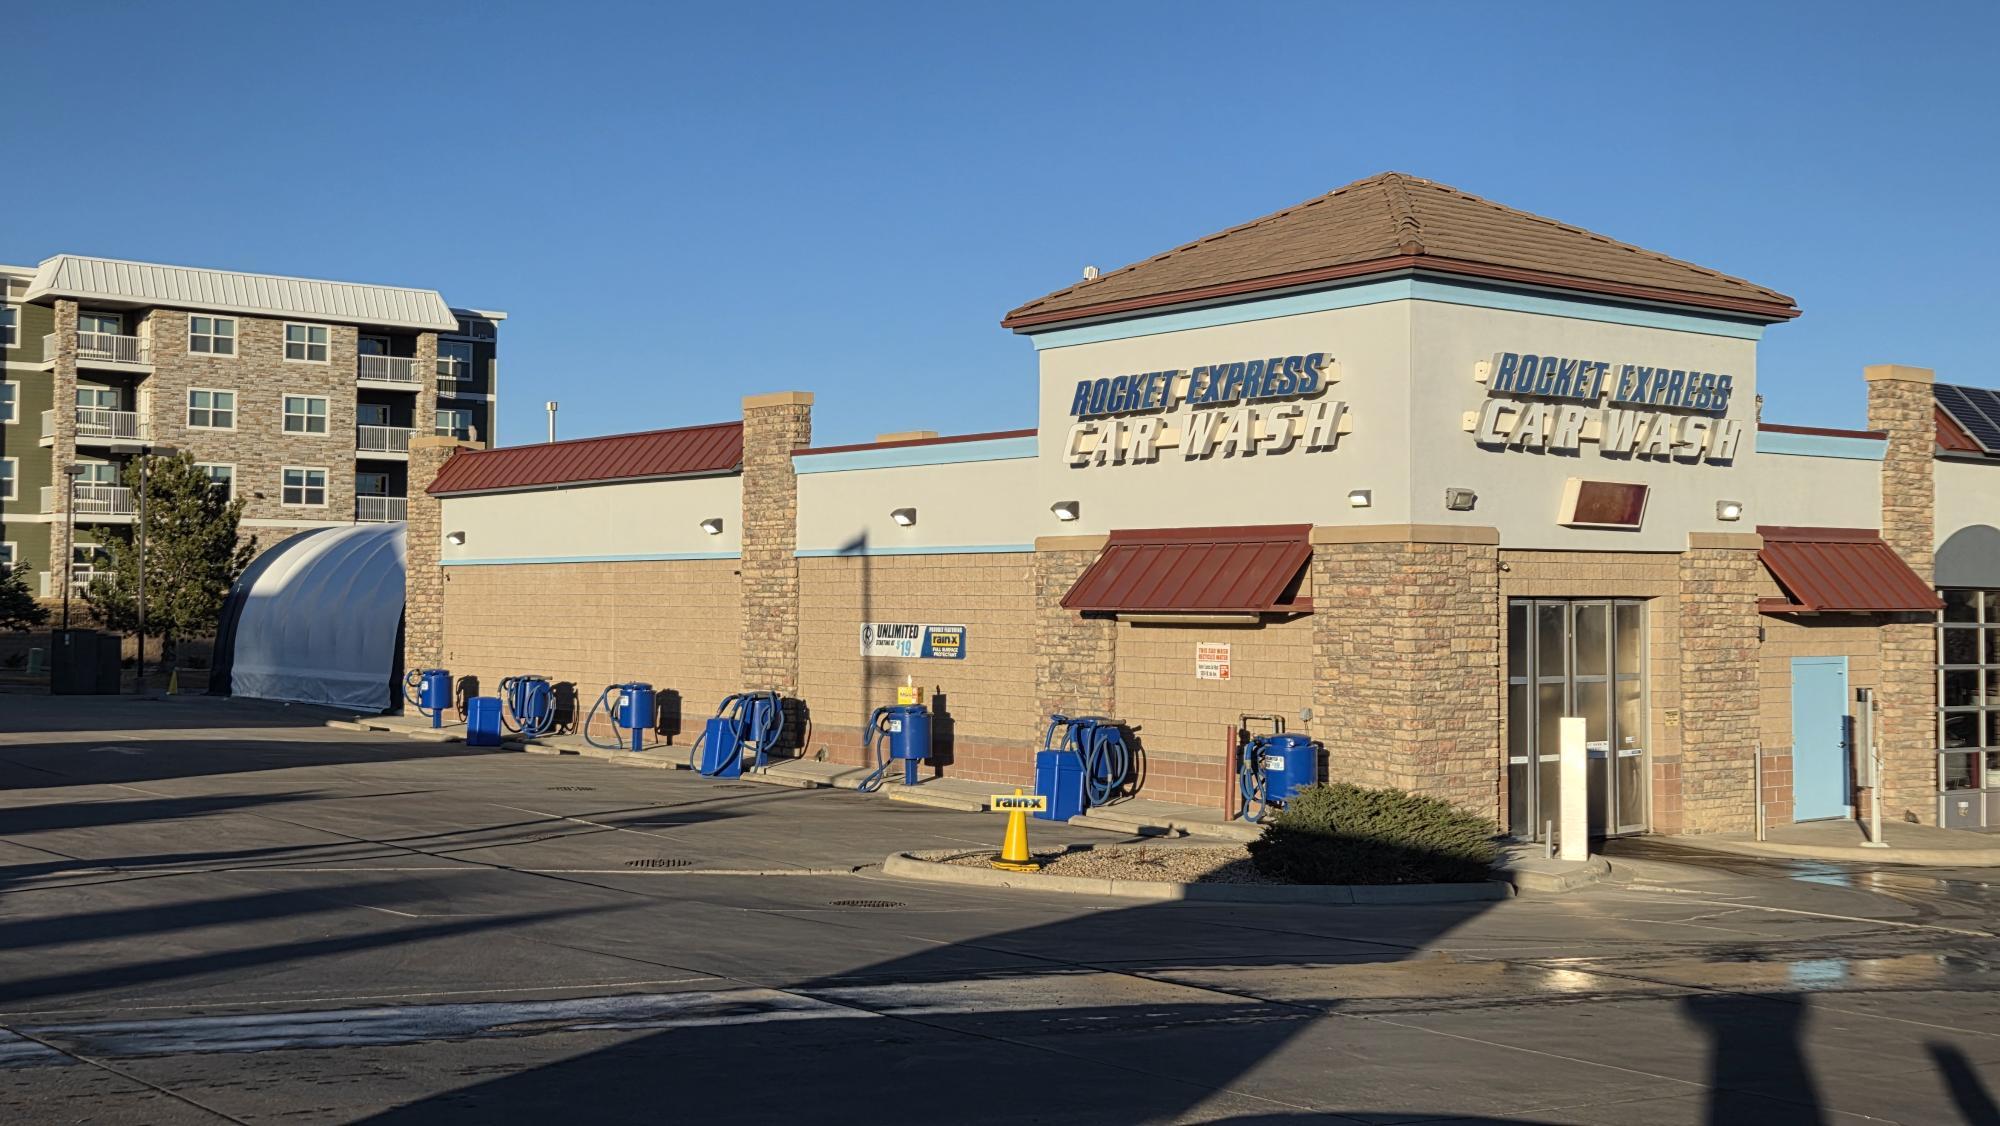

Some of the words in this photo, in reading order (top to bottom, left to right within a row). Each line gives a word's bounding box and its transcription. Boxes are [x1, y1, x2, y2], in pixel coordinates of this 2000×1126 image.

[1070, 369, 1182, 417] ROCKET
[1185, 352, 1328, 405] EXPRESS
[1490, 352, 1610, 400] ROCKET
[1613, 364, 1733, 411] EXPRESS
[1062, 417, 1164, 464] CAR
[1178, 401, 1346, 457] WASH
[1477, 400, 1585, 449] CAR
[1604, 408, 1743, 459] WASH
[877, 624, 919, 639] UNLIMITED
